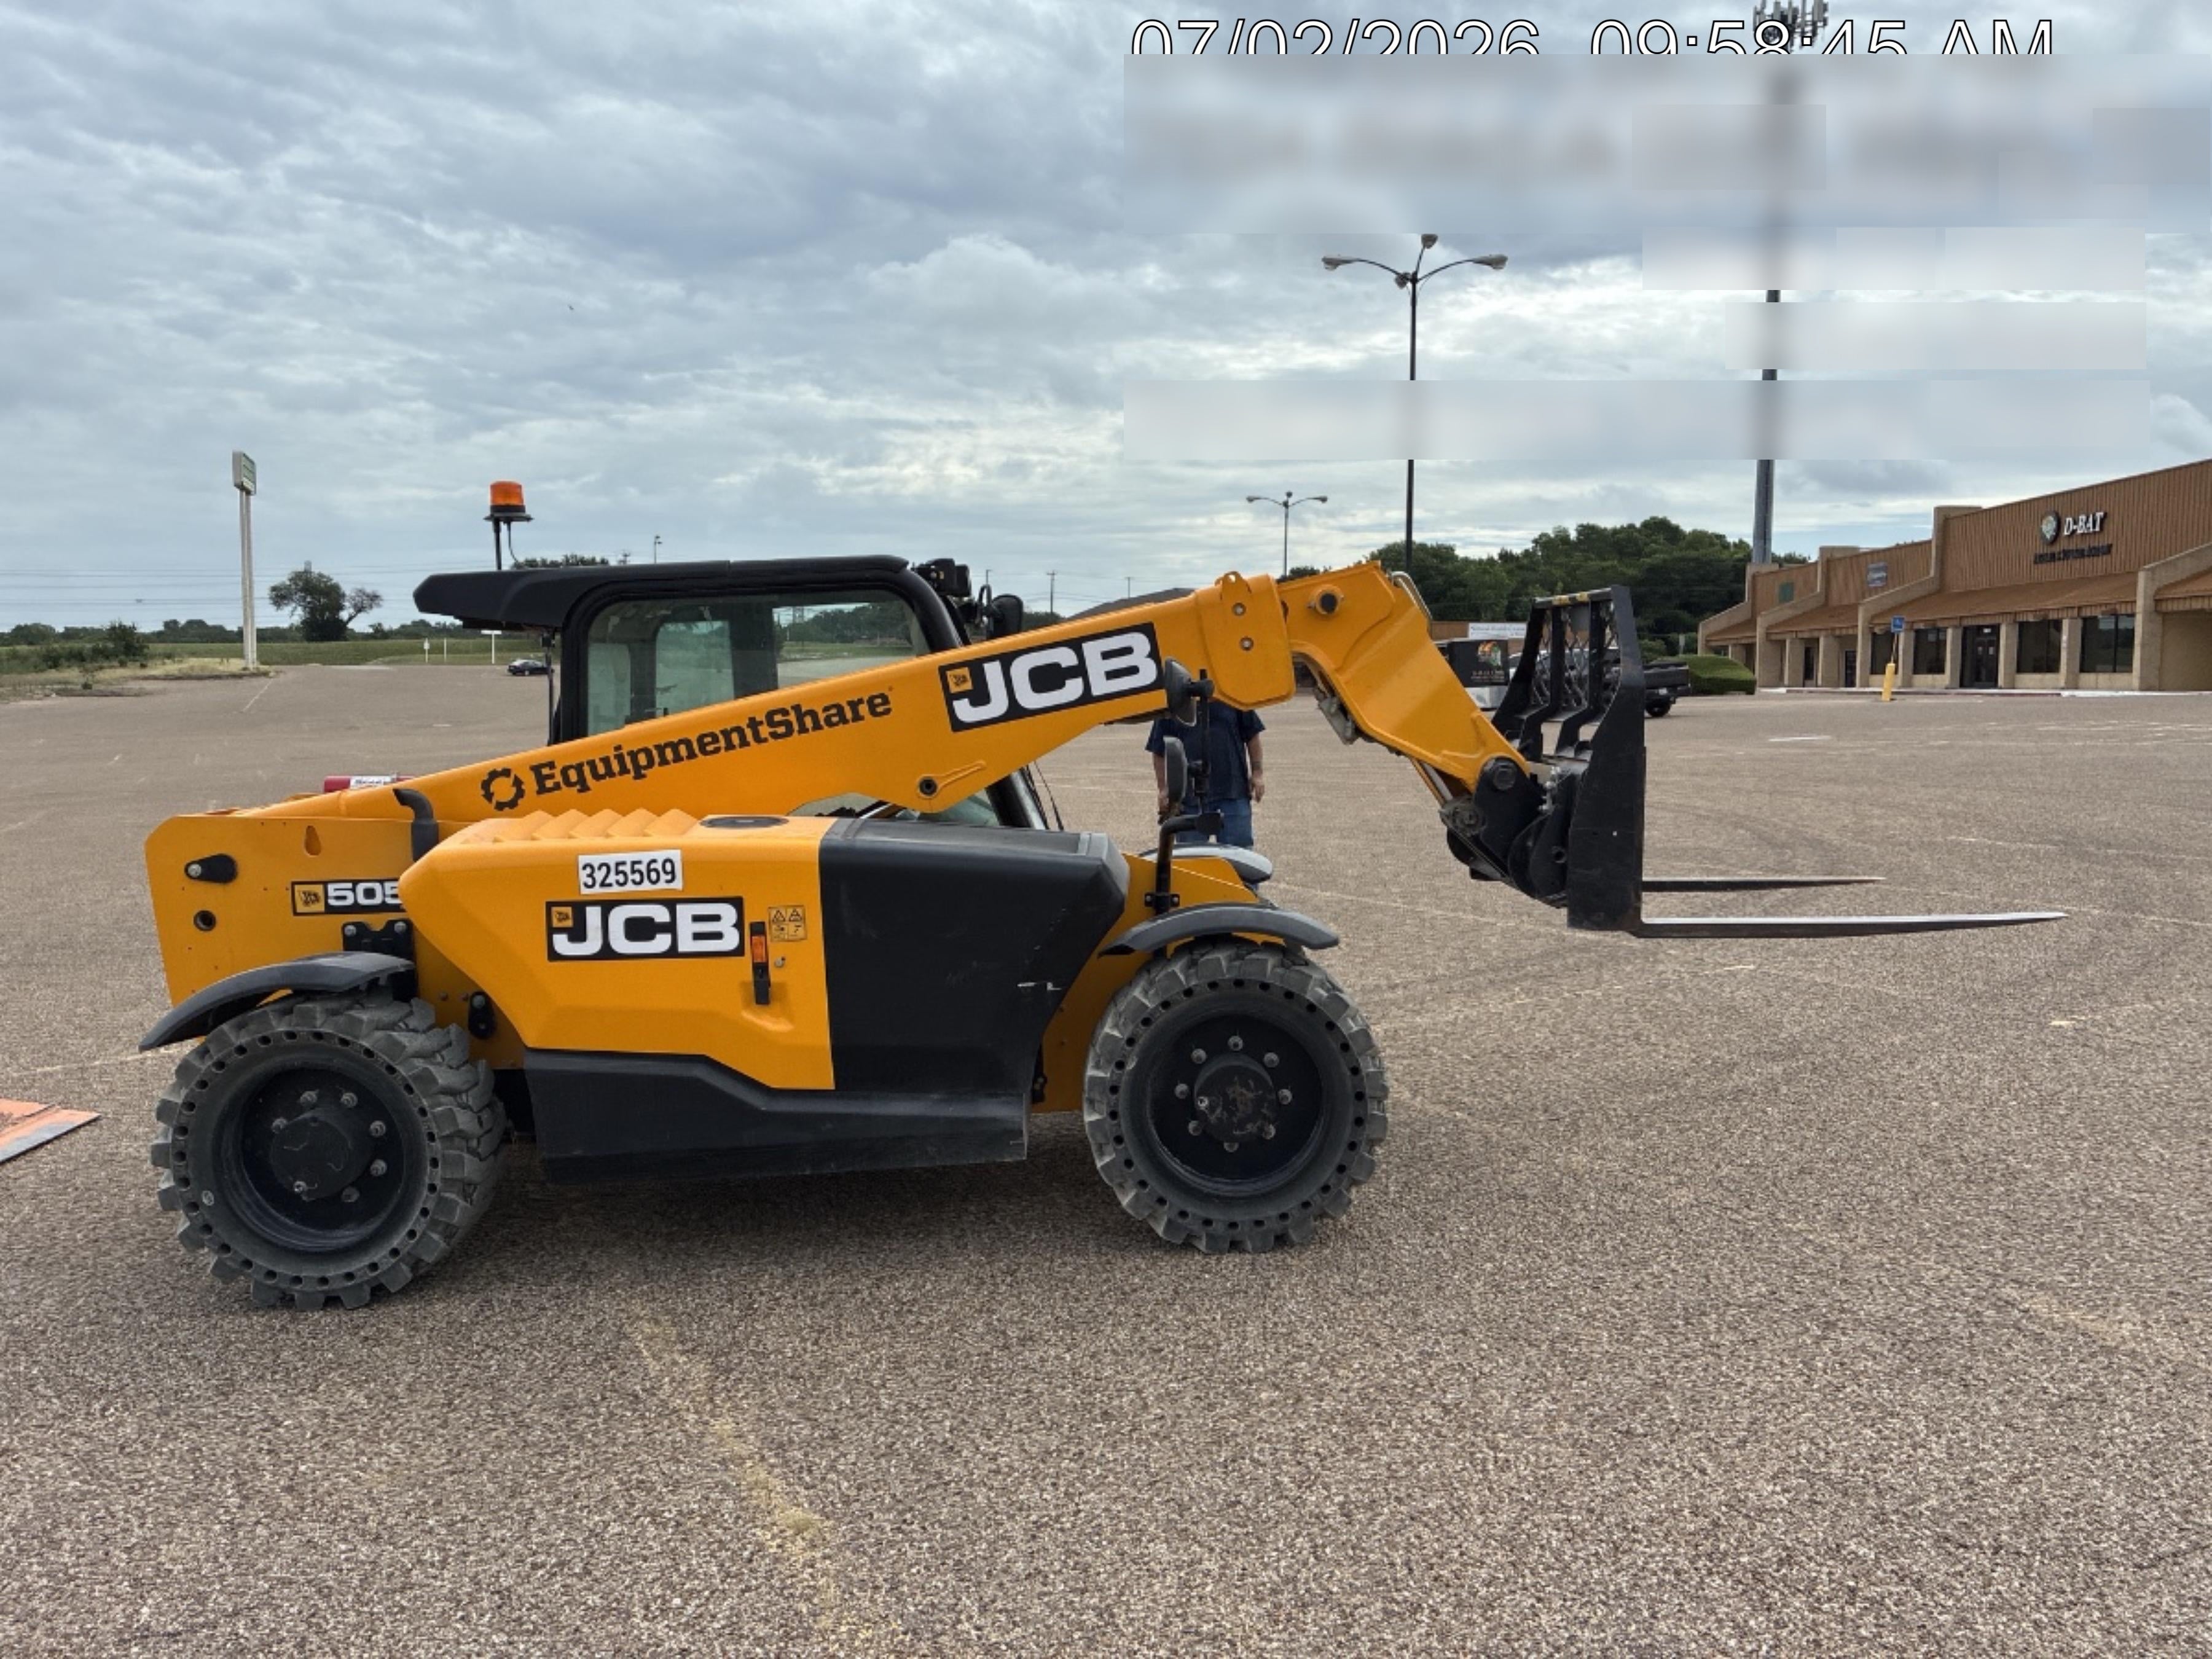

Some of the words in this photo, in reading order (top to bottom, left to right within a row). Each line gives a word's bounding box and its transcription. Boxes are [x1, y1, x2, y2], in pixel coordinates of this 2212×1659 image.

[2064, 511, 2104, 536] D-BAT
[953, 632, 1158, 723] JCB
[530, 691, 893, 795] EquipmentShare
[581, 858, 676, 888] 325569
[553, 903, 740, 955] JCB
